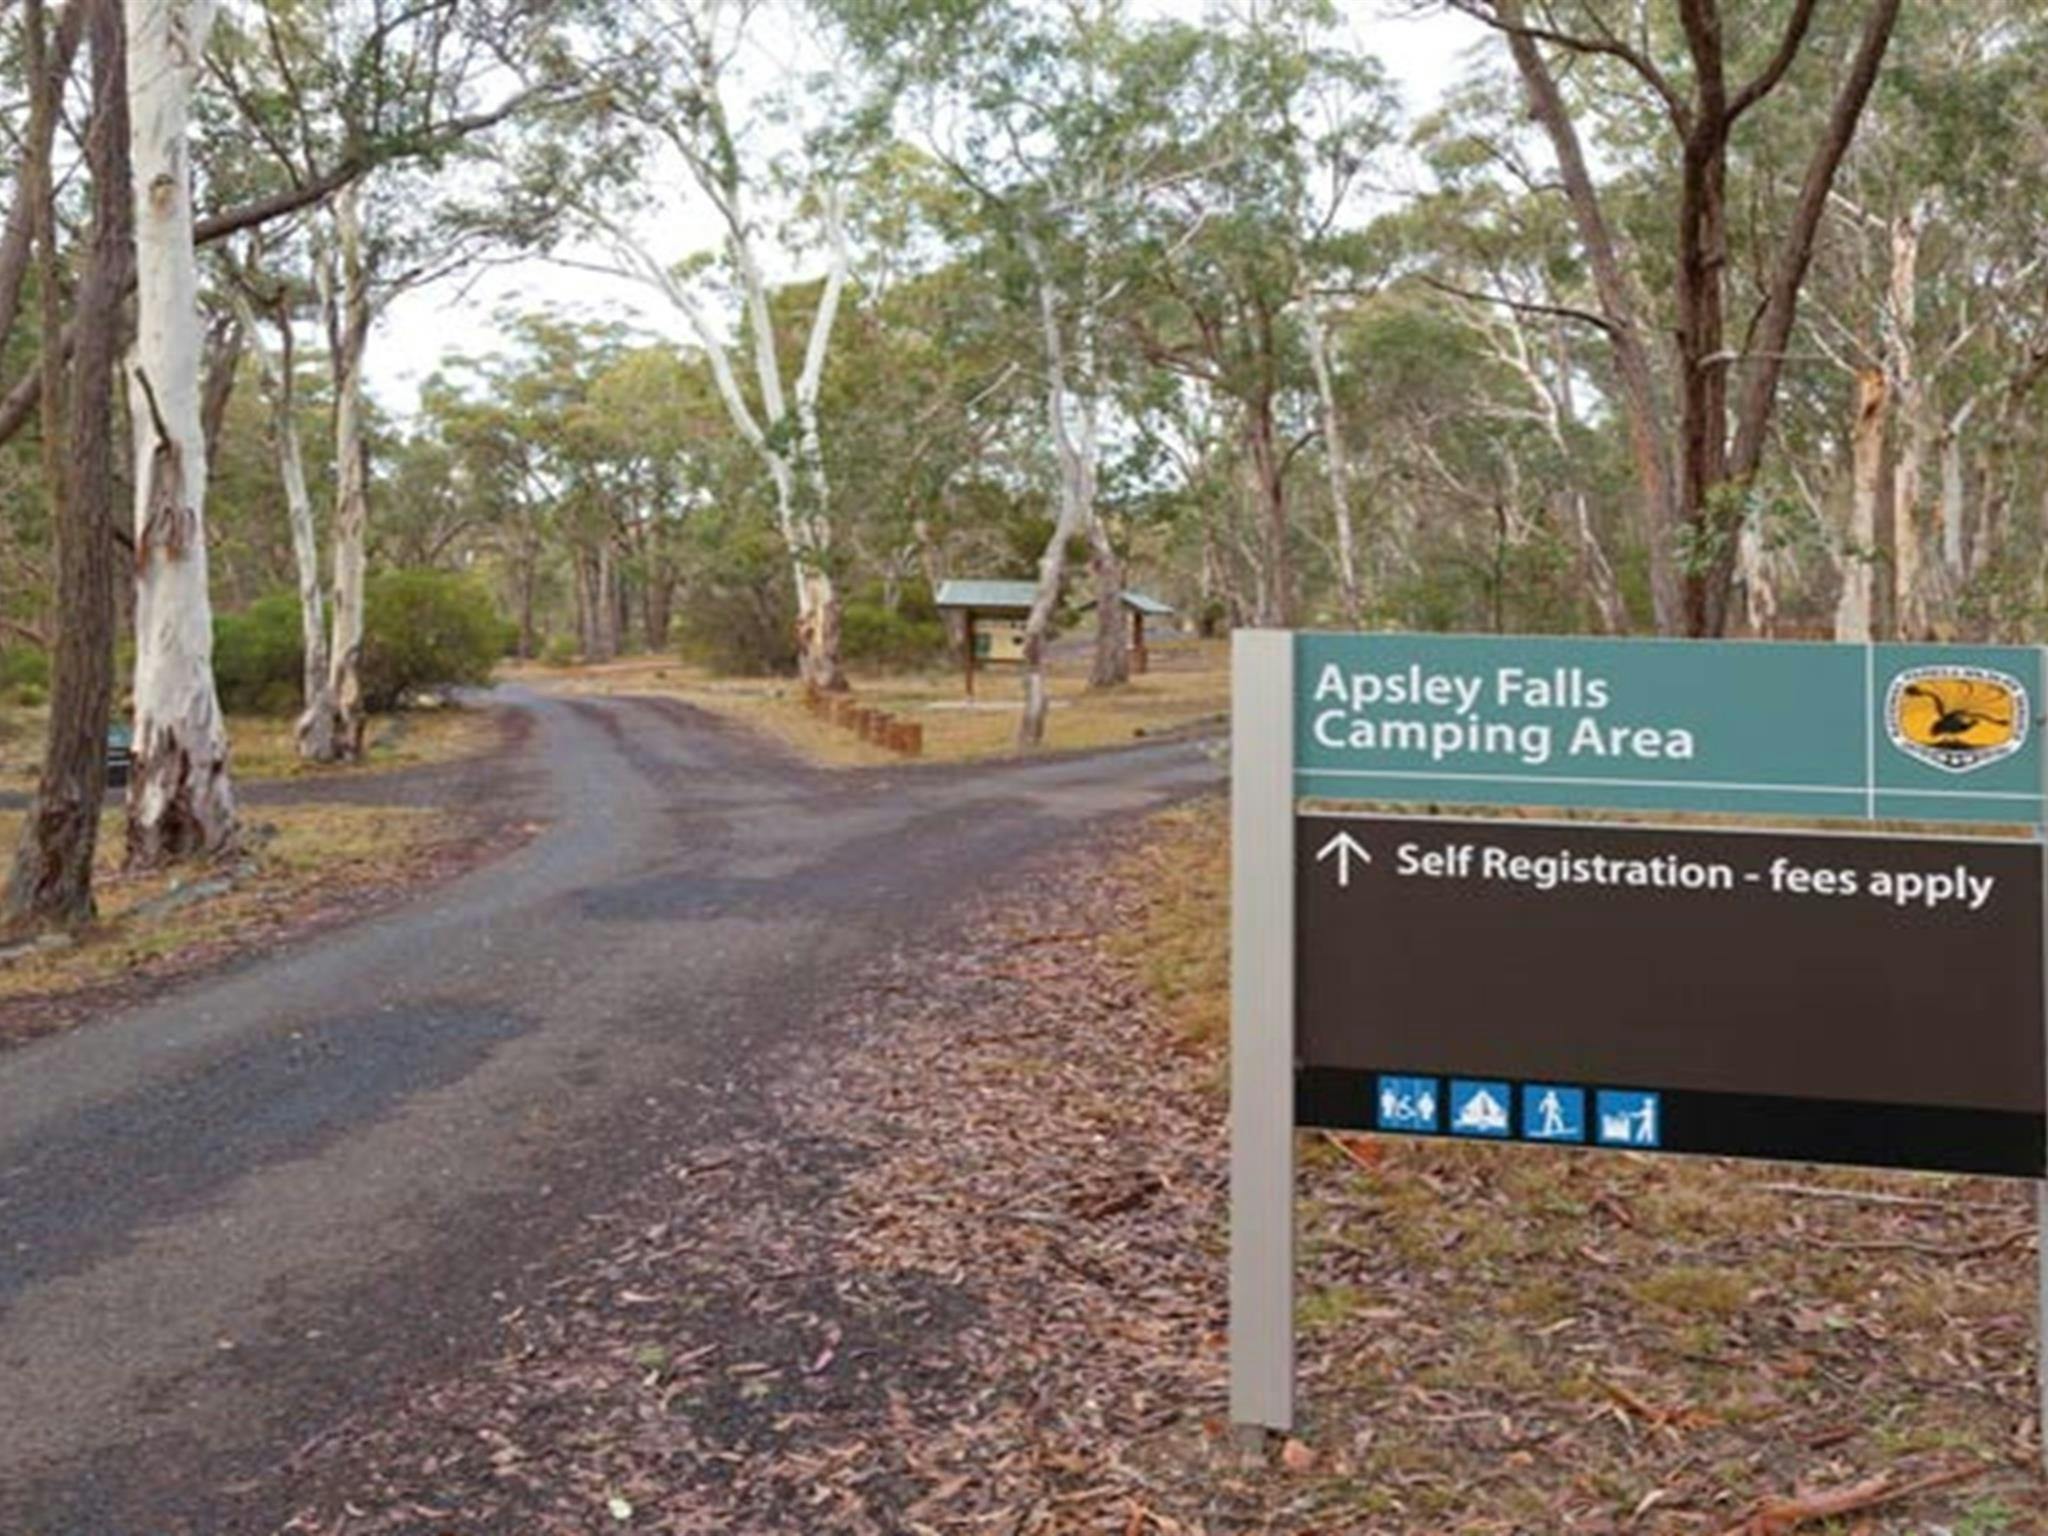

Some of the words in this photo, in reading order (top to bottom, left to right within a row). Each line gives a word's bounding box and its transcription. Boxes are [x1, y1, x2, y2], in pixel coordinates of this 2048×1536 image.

[1314, 663, 1482, 714] Apsley
[1497, 666, 1609, 709] Falls
[1313, 709, 1551, 764] Camping
[1569, 717, 1694, 759] Area
[1397, 842, 1475, 878] Self
[1482, 846, 1733, 890] Registration
[1769, 857, 1859, 895] fees
[1868, 865, 1994, 910] apply
